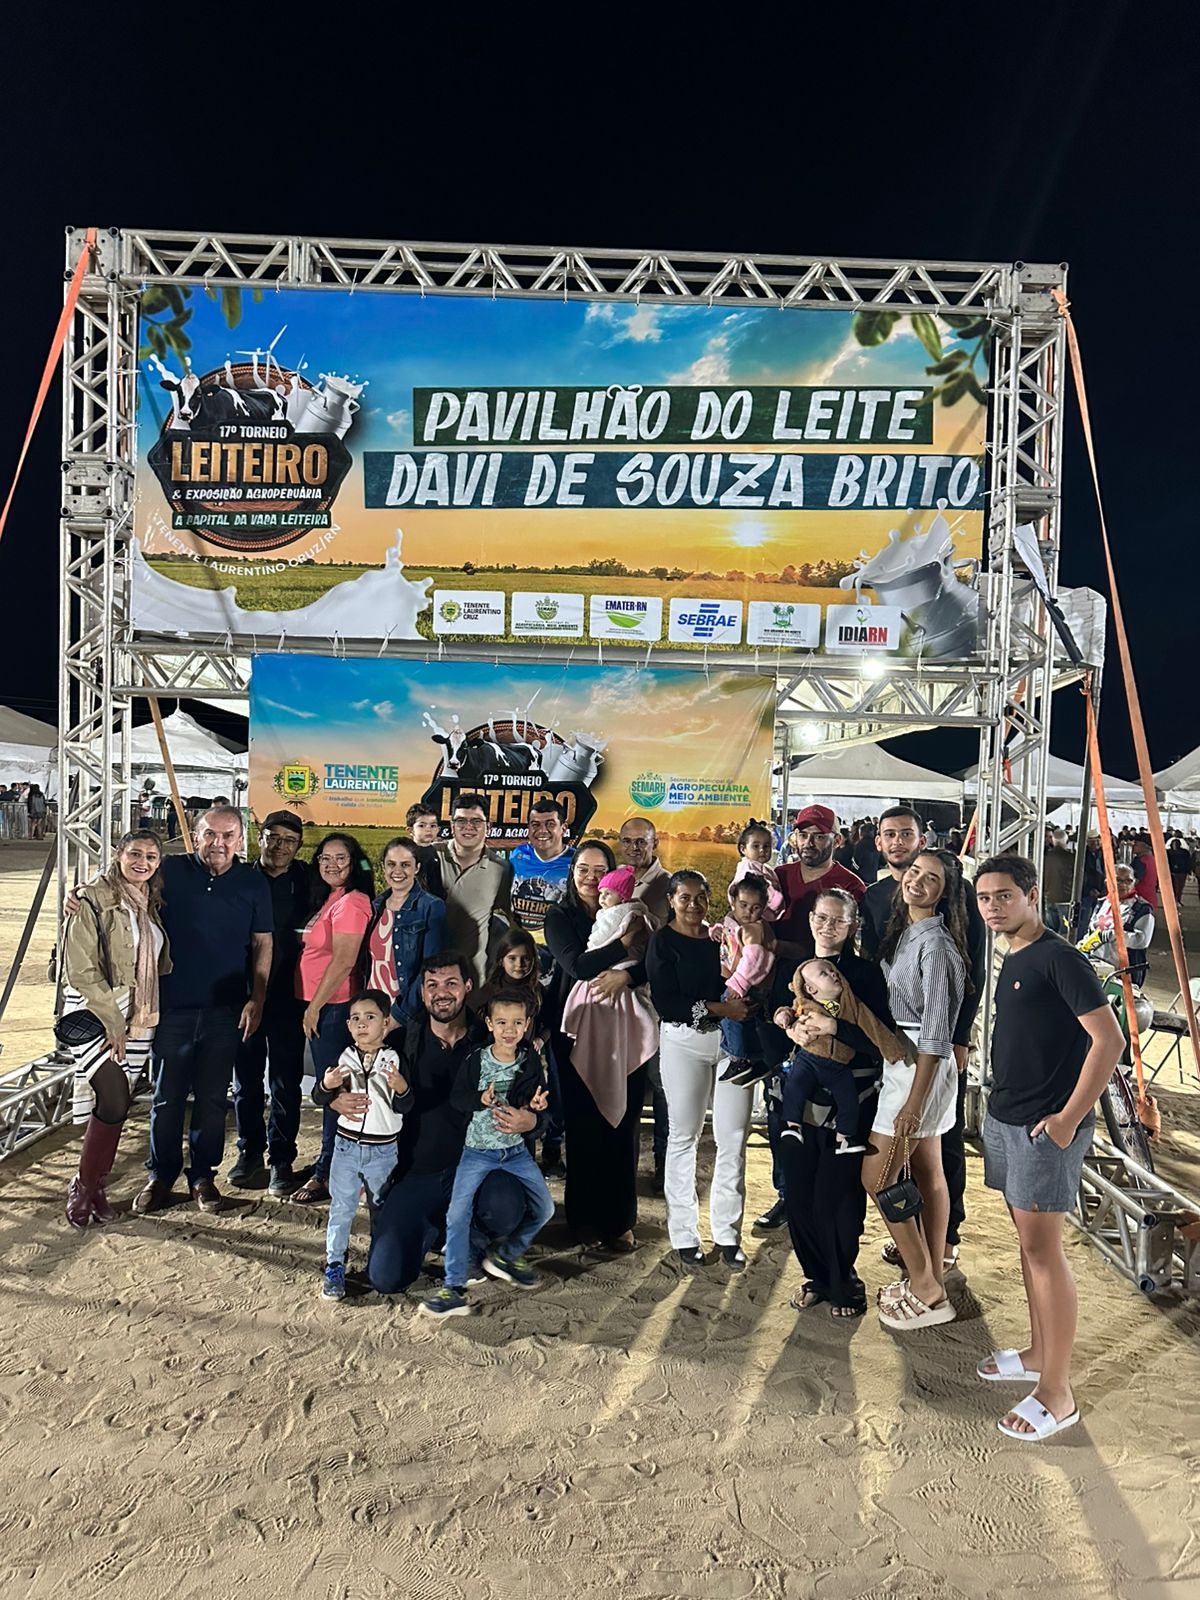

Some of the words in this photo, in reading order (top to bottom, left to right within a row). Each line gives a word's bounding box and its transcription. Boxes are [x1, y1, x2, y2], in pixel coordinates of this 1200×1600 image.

[423, 384, 668, 441] PAVILHÃO
[691, 391, 752, 441] DO
[772, 390, 918, 441] LEITE
[240, 426, 288, 439] TORNEIO
[171, 441, 329, 486] LEITEIRO
[385, 453, 502, 506] DAVI
[523, 453, 595, 506] DE
[616, 453, 804, 507] SOUZA
[828, 454, 981, 507] BRITO
[172, 490, 182, 500] &
[175, 515, 184, 526] A
[234, 514, 248, 526] DA
[281, 514, 329, 526] LEITEIRA
[155, 517, 201, 564] TENENTE
[203, 559, 286, 576] LAURENTINO
[677, 613, 738, 627] SEBRAE
[838, 626, 888, 643] IDIARN
[324, 763, 399, 780] TENENTE
[324, 780, 397, 791] LAURENTINO
[501, 775, 542, 787] TORNEIO
[631, 780, 666, 793] SEMARH
[669, 792, 695, 800] MEIO
